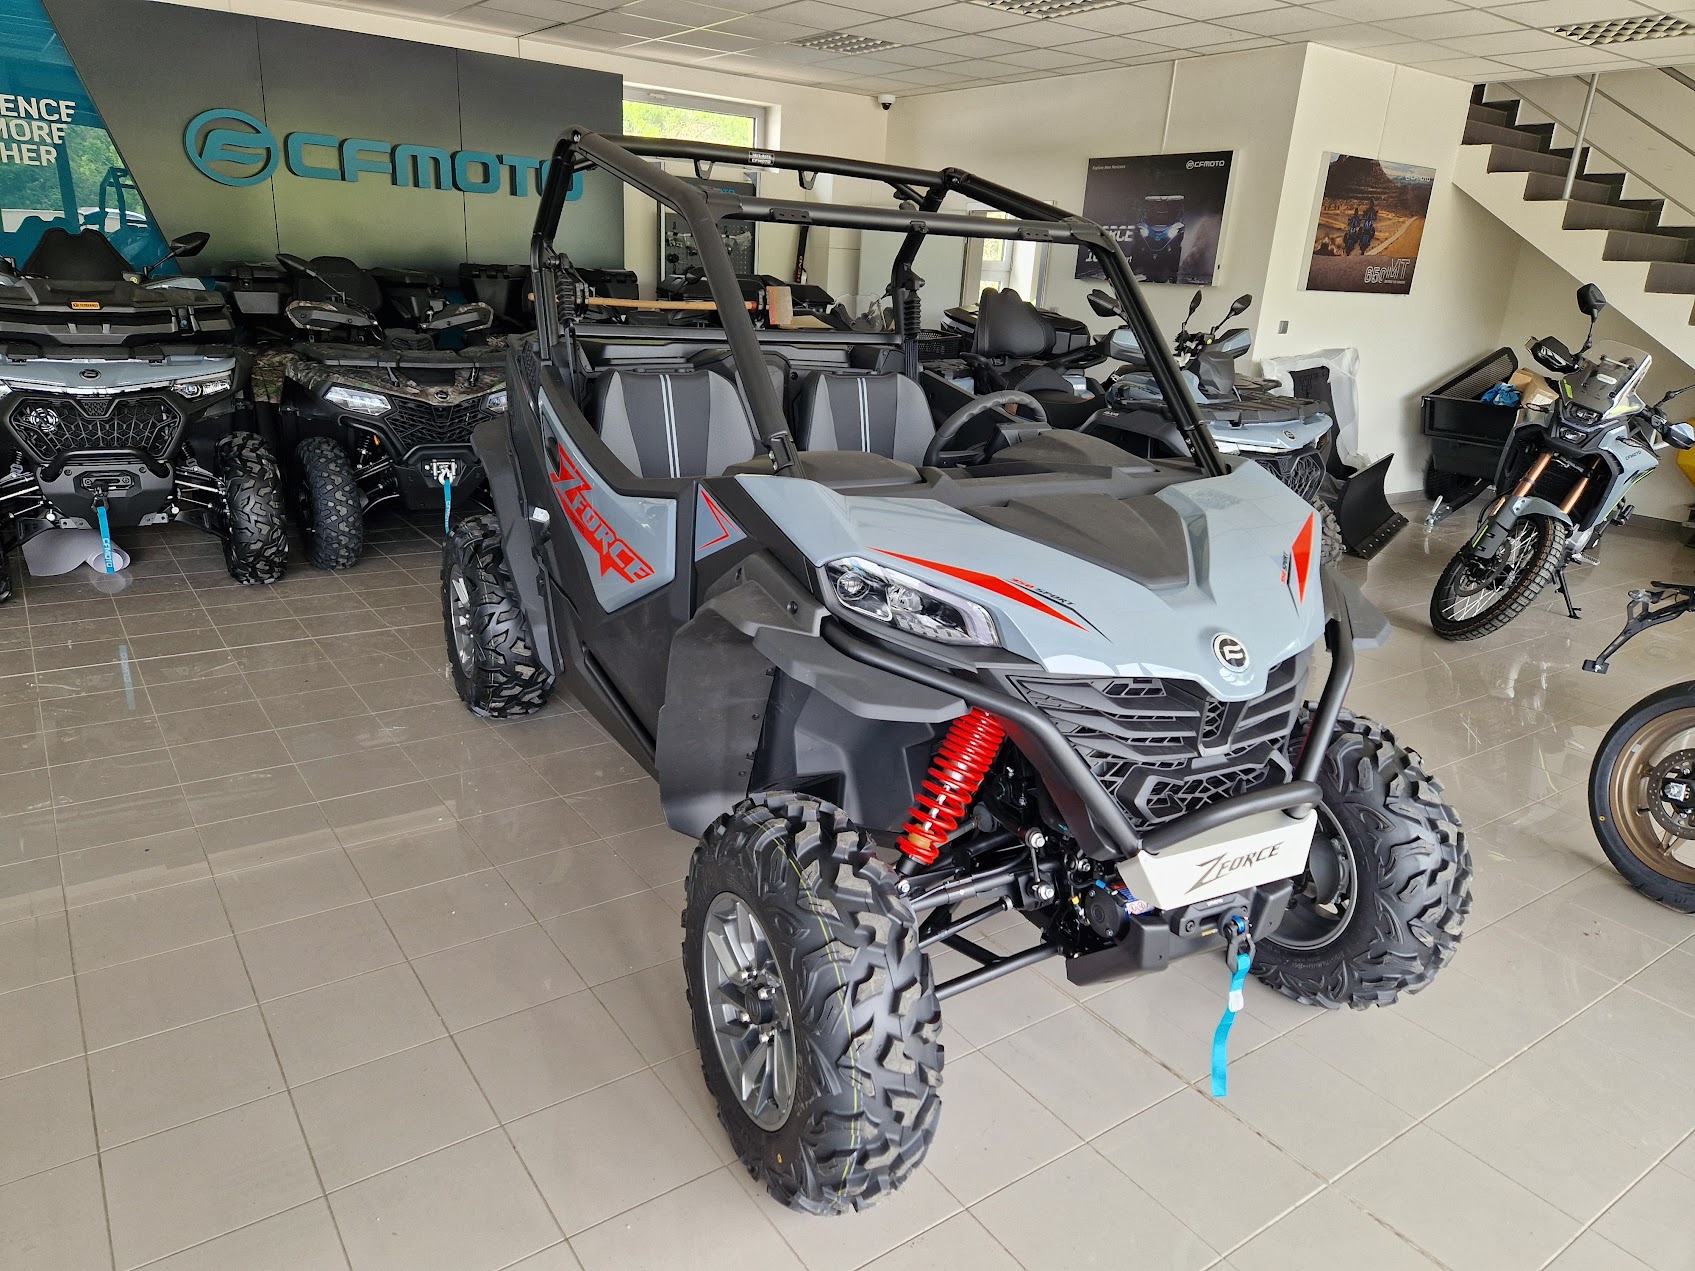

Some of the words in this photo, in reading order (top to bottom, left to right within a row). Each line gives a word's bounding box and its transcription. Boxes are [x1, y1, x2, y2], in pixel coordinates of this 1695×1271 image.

[0, 94, 76, 122] ENCE
[0, 142, 57, 166] HER
[285, 131, 584, 201] CFMOTO
[1194, 160, 1225, 168] CFMOTO
[1035, 587, 1076, 606] SPORT
